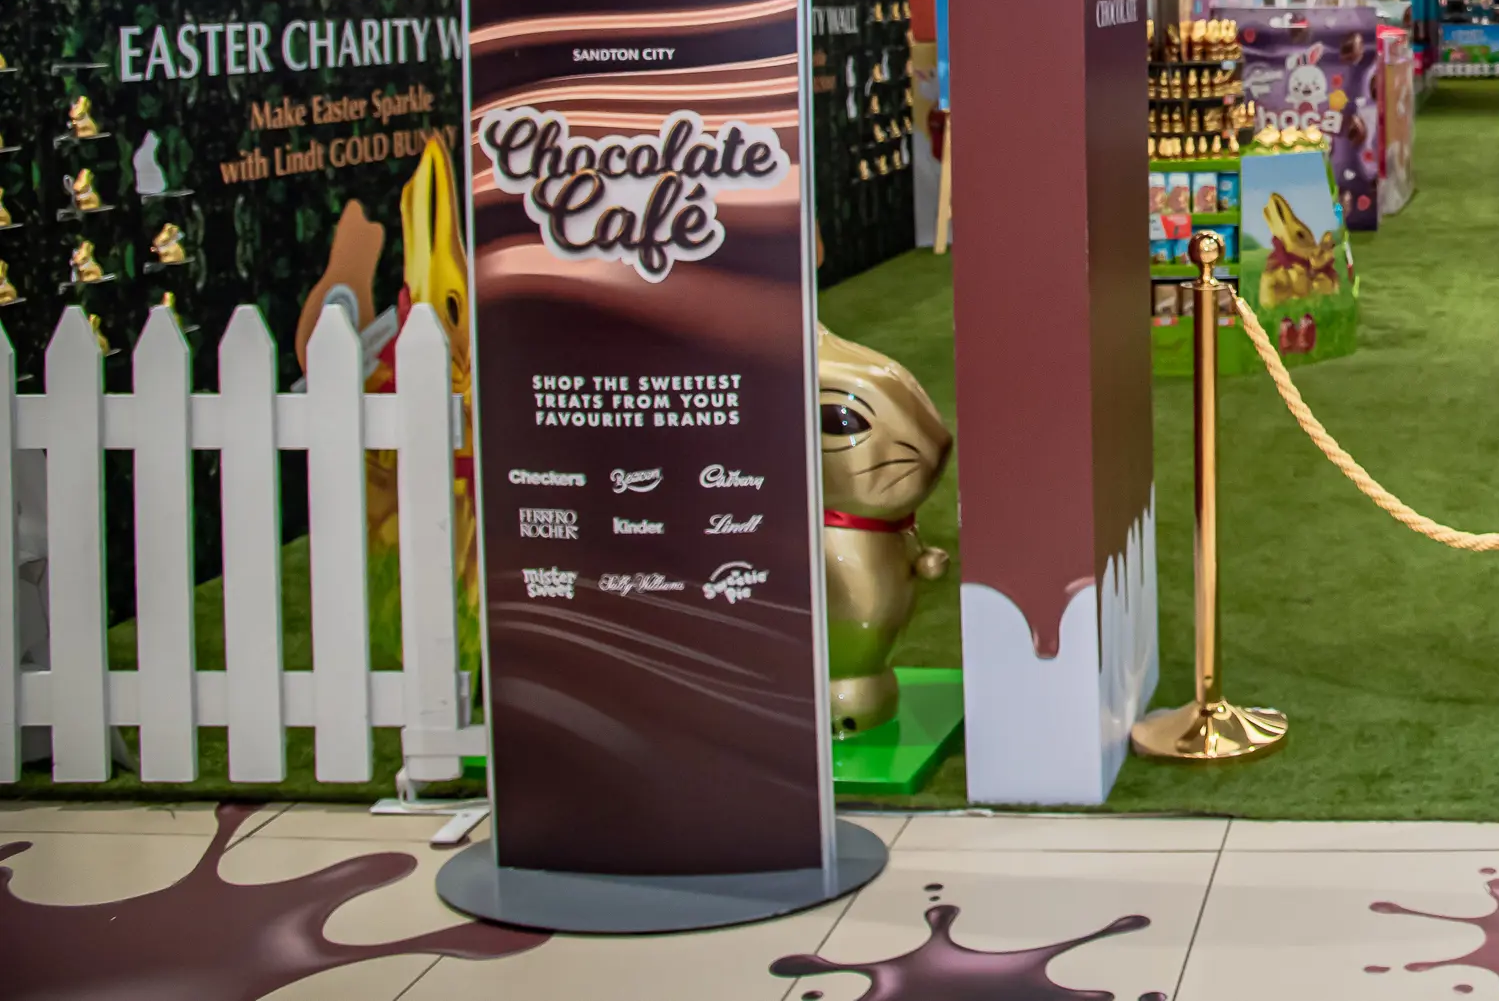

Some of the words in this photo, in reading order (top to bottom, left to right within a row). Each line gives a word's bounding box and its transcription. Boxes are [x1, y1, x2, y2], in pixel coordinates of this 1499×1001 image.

[119, 21, 274, 83] EASTER
[281, 17, 431, 73] CHARITY
[572, 48, 639, 61] SANDTON
[642, 48, 676, 61] CITY
[250, 96, 307, 131] Make
[311, 94, 369, 125] Easter
[371, 80, 435, 125] Sparkle
[484, 116, 778, 180] Chocolate
[219, 149, 269, 185] with
[274, 138, 326, 177] Lindt
[329, 131, 389, 168] GOLD
[532, 168, 716, 274] Café
[532, 375, 585, 391] SHOP
[592, 376, 629, 391] THE
[639, 374, 742, 391] SWEETEST
[534, 393, 603, 409] TREATS
[612, 394, 671, 409] FROM
[679, 393, 739, 407] YOUR
[535, 411, 643, 427] FAVOURITE
[654, 410, 740, 427] BRANDS
[508, 469, 587, 487] Checkers
[699, 464, 764, 490] Cadbury
[519, 507, 577, 525] FERRERO
[704, 513, 763, 535] Lindt
[519, 523, 579, 540] ROCHER
[612, 517, 664, 535] Kinder
